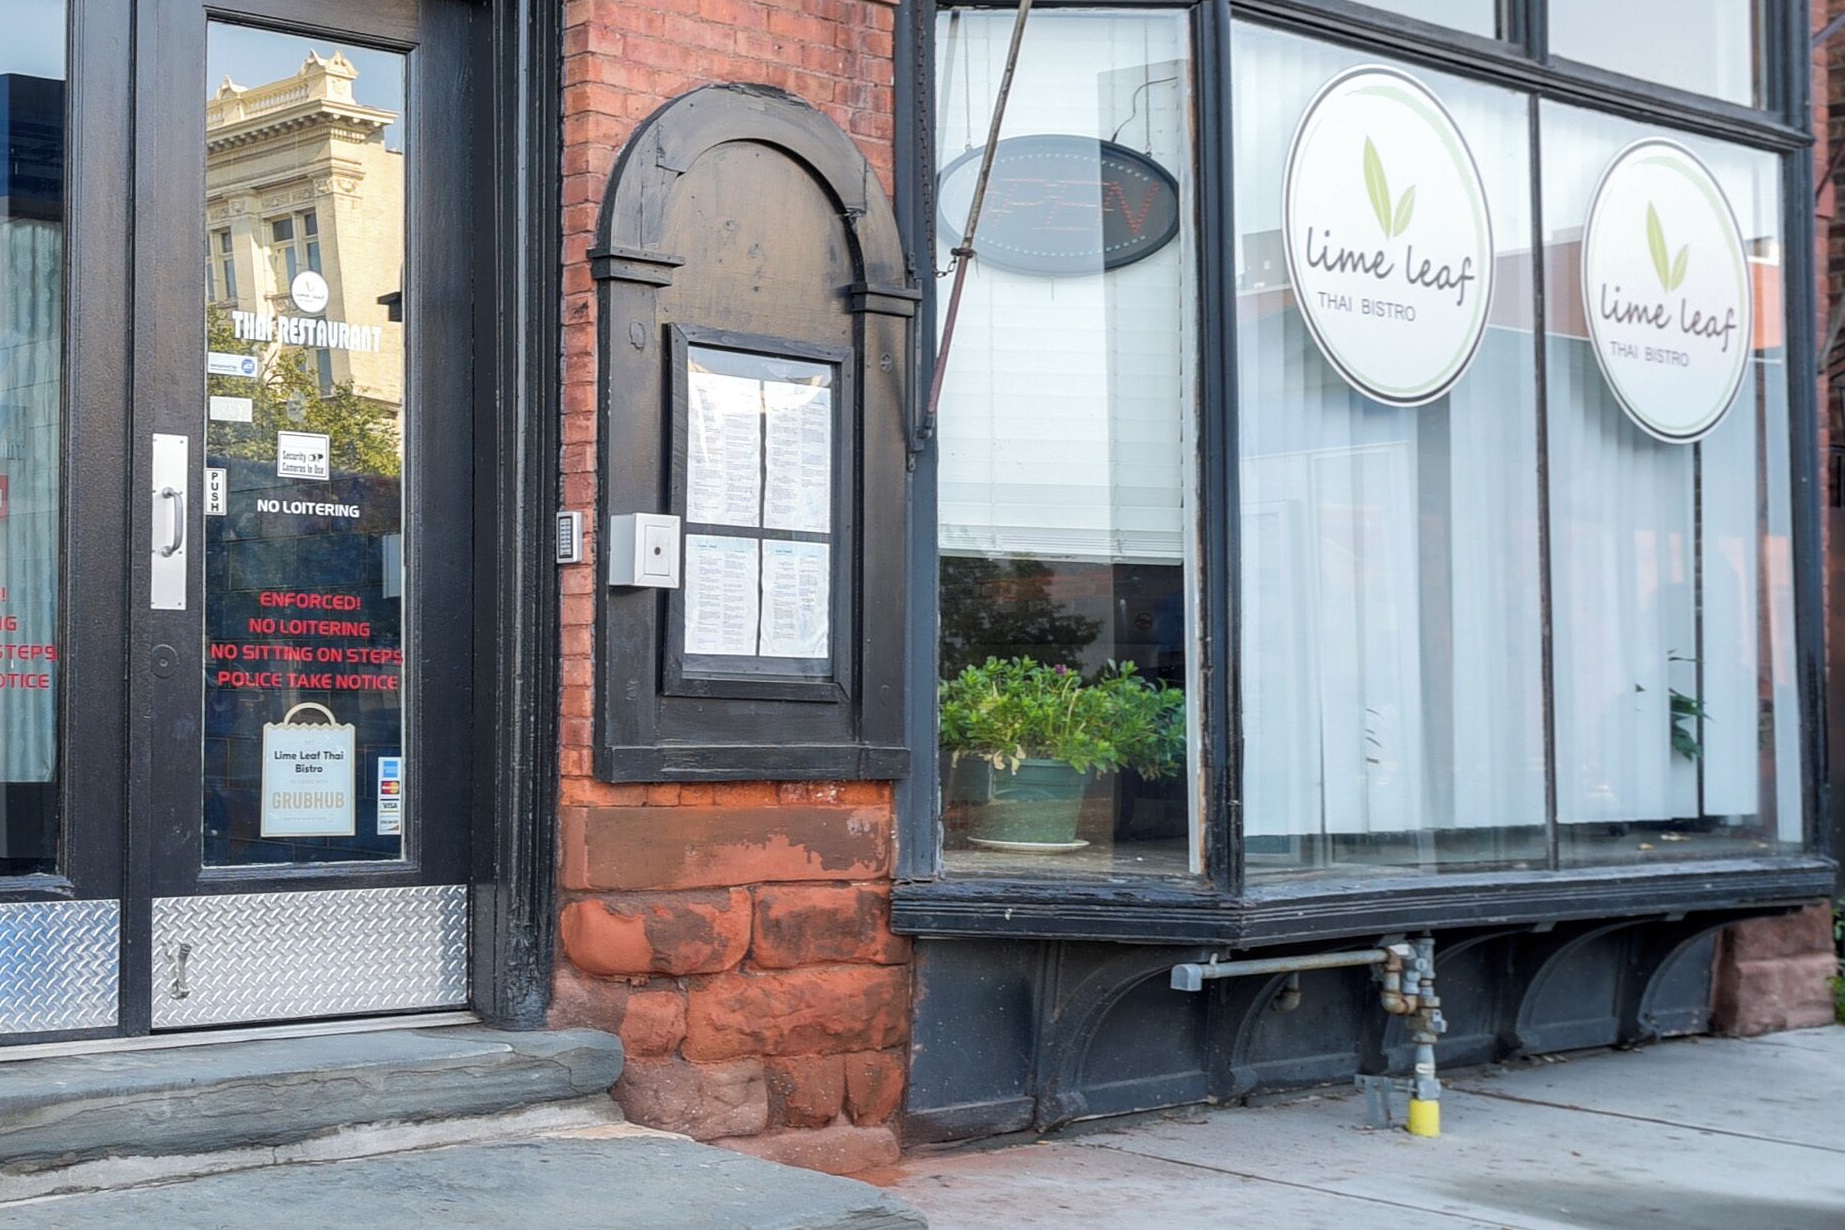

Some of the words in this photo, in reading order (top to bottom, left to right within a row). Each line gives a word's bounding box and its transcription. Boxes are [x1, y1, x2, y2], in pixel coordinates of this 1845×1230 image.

[1306, 226, 1395, 280] lime
[1405, 244, 1475, 307] leaf
[1317, 291, 1353, 313] THAI
[1361, 298, 1417, 322] BISTRO
[1600, 283, 1672, 330] lime
[1680, 298, 1738, 353] leaf
[232, 310, 274, 341] THAI
[277, 315, 383, 353] RESTAURANT
[1609, 340, 1640, 359] THAI
[1644, 345, 1690, 368] BISTRO
[210, 472, 220, 512] PUSH
[257, 499, 280, 513] NO
[282, 500, 360, 518] LOITERING
[260, 591, 362, 611] ENFORCED!
[248, 618, 275, 634] NO
[280, 619, 371, 637] LOITERING
[210, 644, 238, 659] NO
[242, 645, 313, 661] SITTING
[317, 647, 342, 662] ON
[346, 648, 404, 665] STEPS
[218, 671, 282, 687] POLICE
[287, 673, 333, 689] TAKE
[336, 674, 398, 690] NOTICE
[274, 750, 297, 760] Lime
[300, 750, 321, 760] Leaf
[324, 751, 344, 760] Thai
[295, 764, 323, 774] Bistro
[272, 792, 344, 810] GRUBHUB
